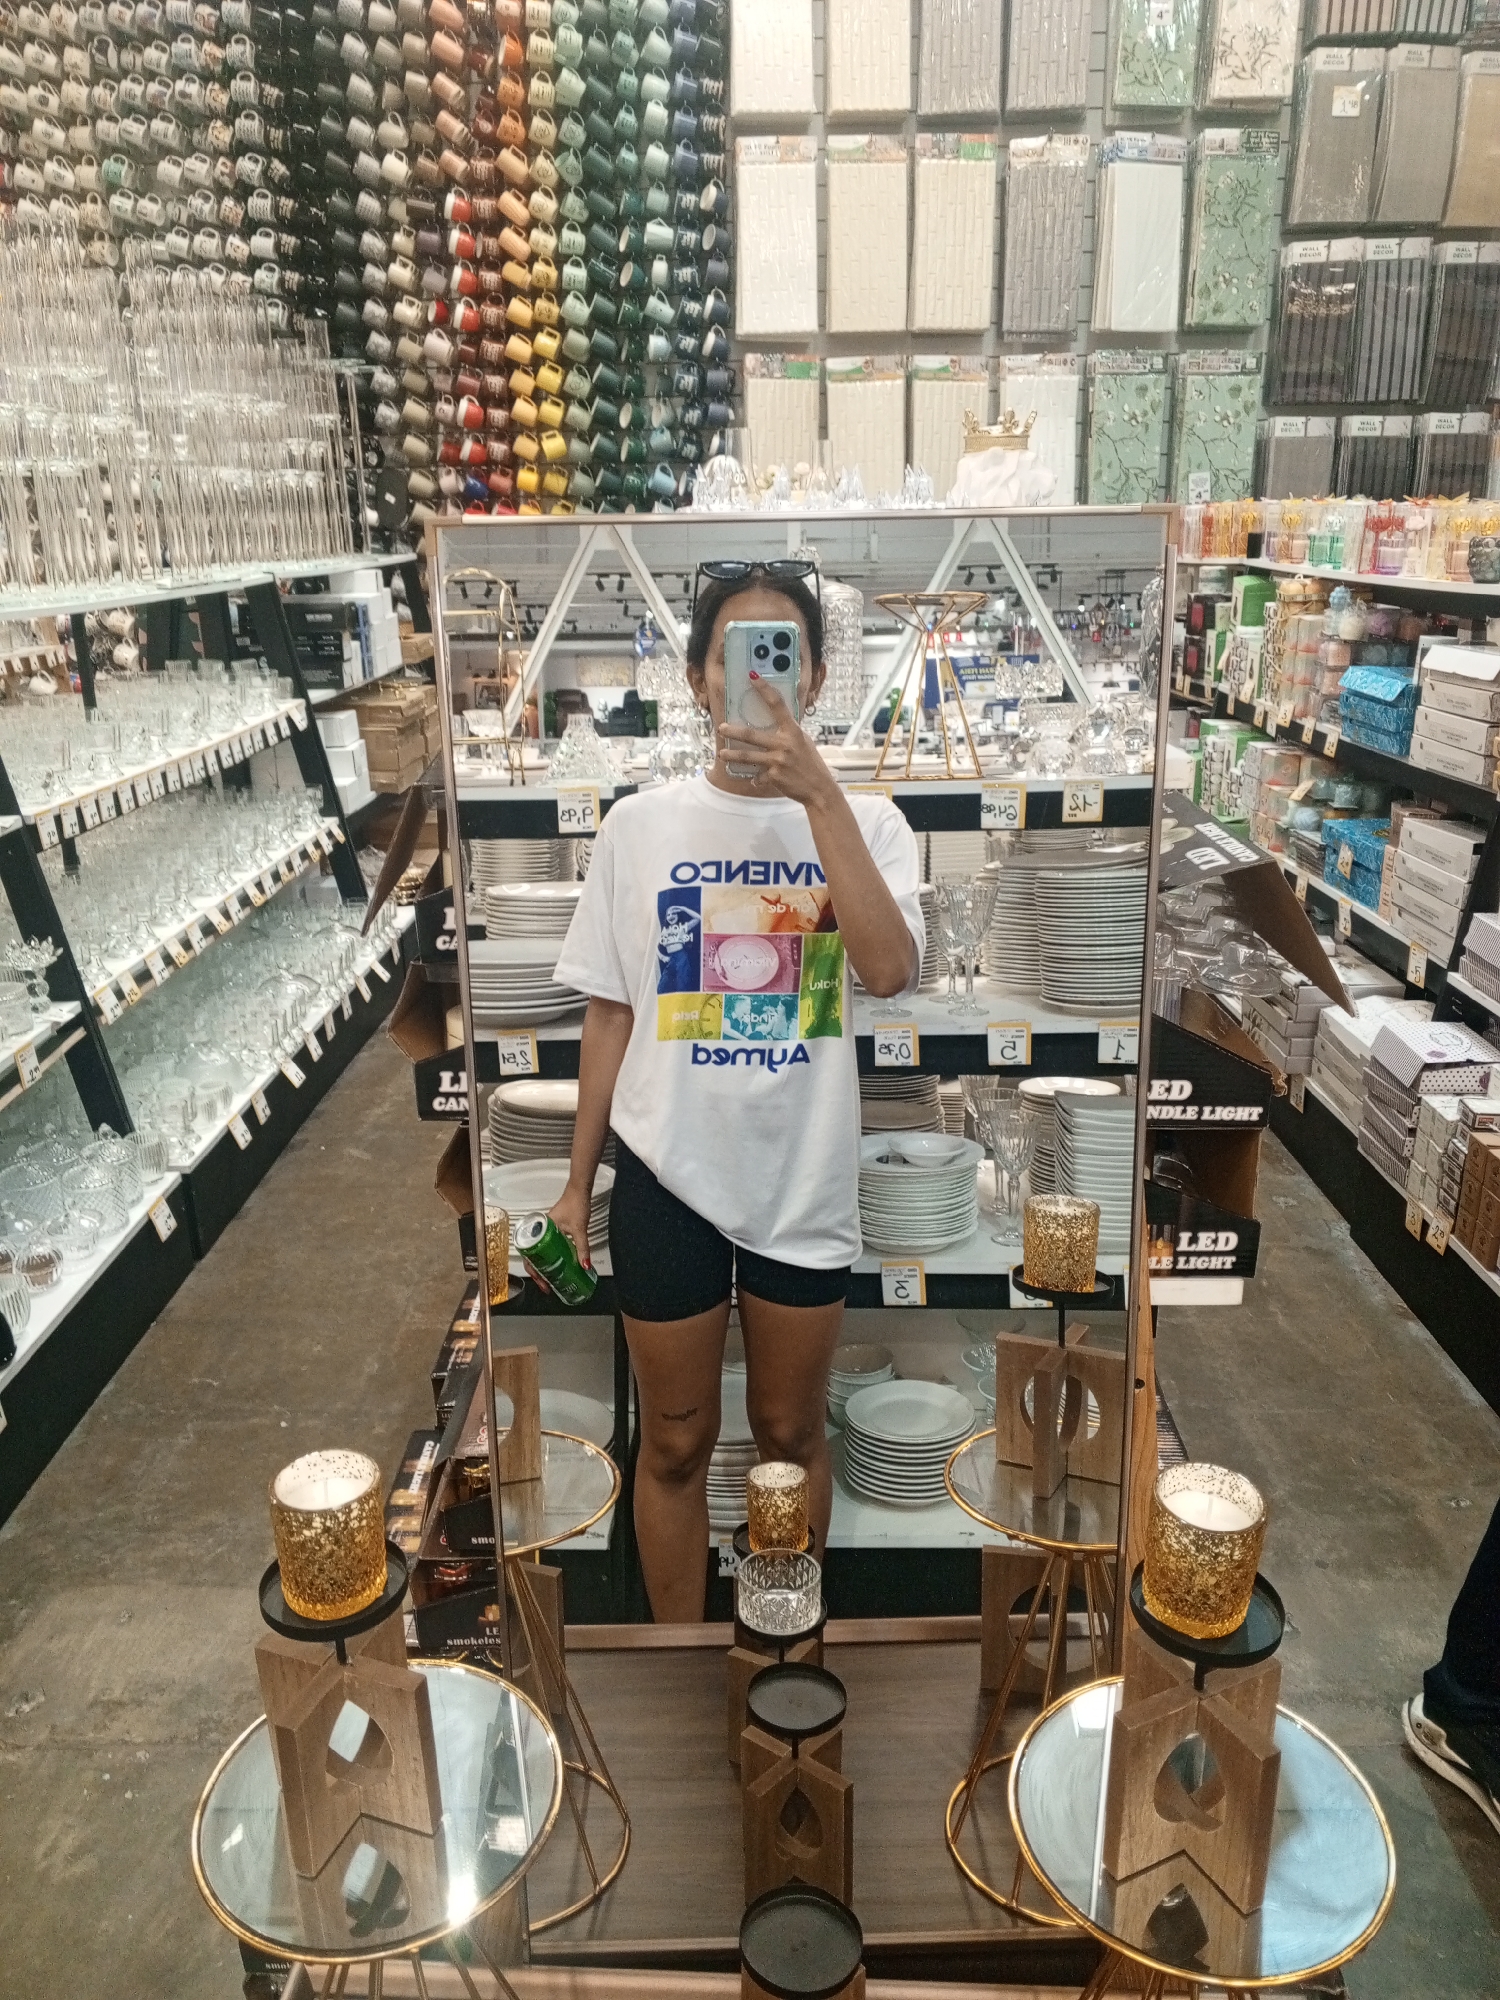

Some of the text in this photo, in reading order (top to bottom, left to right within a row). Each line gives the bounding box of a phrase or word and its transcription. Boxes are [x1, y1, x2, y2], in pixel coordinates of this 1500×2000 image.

[1148, 1080, 1193, 1101] ED
[1201, 1106, 1263, 1121] LIGHT
[1176, 1231, 1238, 1252] LED
[1176, 1256, 1236, 1270] LIGHT
